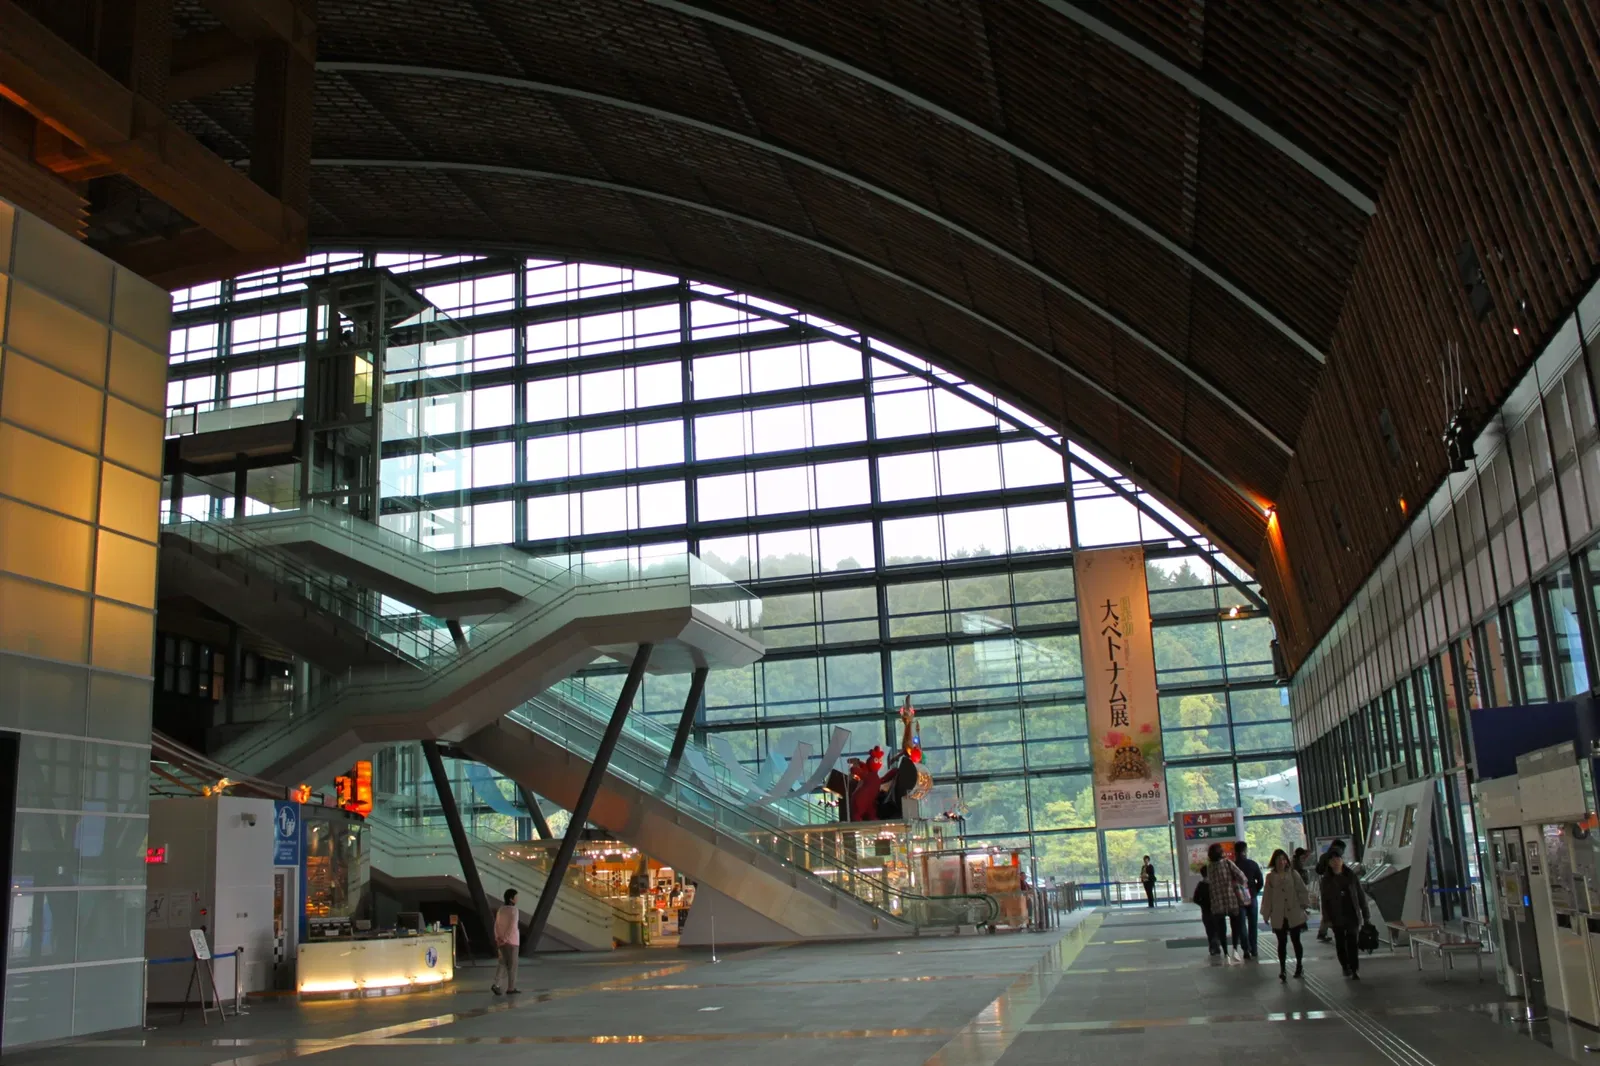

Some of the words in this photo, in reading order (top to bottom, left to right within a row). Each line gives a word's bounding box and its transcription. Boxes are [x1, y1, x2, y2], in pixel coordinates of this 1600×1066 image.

[1100, 599, 1129, 728] 大ベトナム展
[1197, 814, 1208, 824] 4F
[1198, 828, 1209, 838] 3F
